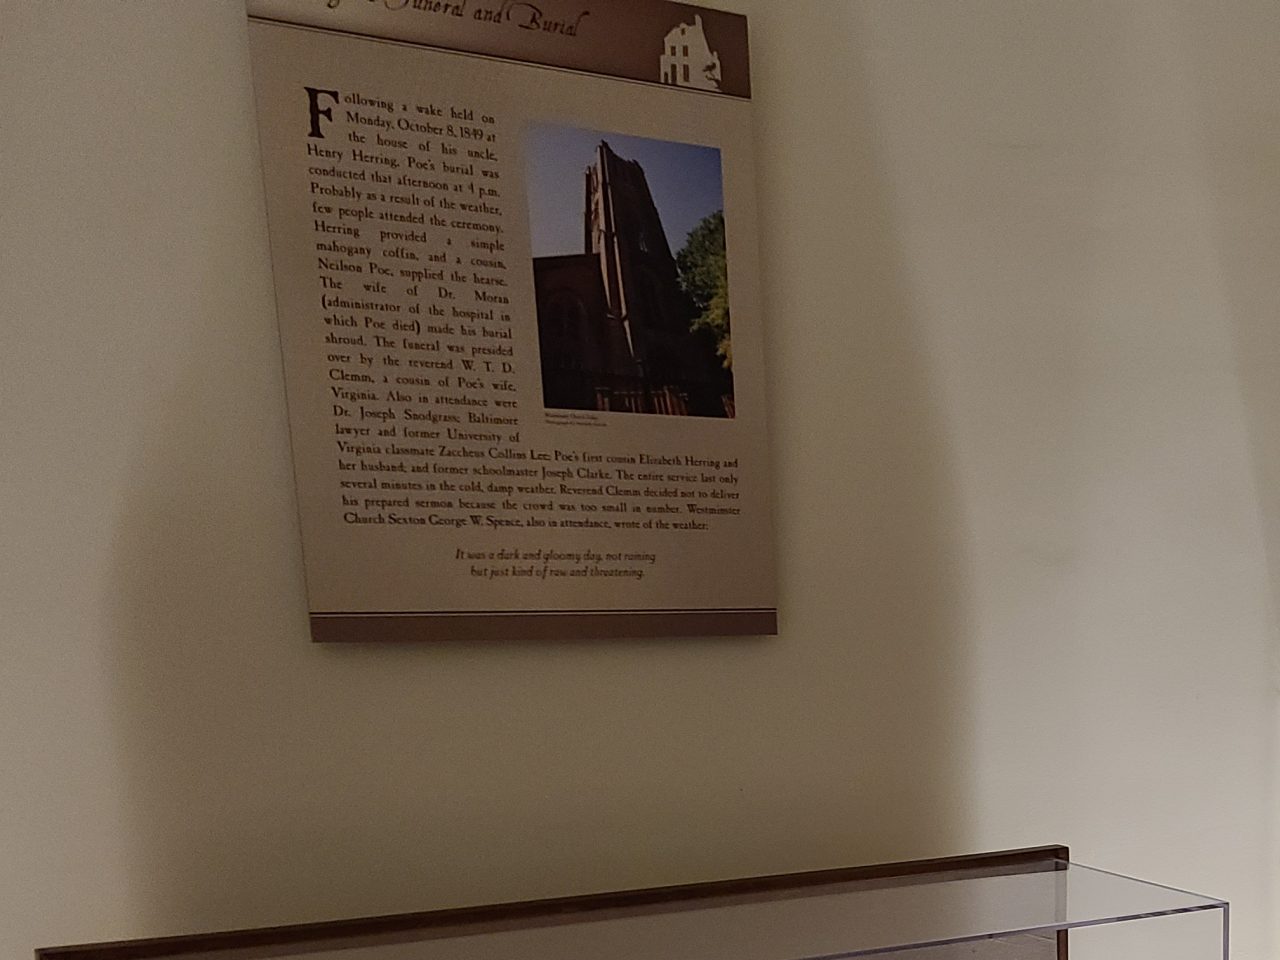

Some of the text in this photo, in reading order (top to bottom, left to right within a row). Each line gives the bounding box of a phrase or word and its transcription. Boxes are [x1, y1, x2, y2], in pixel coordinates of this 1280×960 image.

[473, 6, 502, 24] and
[506, 2, 590, 37] Burial
[415, 104, 442, 116] wake
[450, 106, 473, 121] held
[481, 115, 494, 124] on
[347, 130, 365, 143] the
[376, 133, 407, 148] house
[417, 140, 430, 151] of
[441, 142, 457, 154] his
[396, 118, 443, 135] October
[459, 126, 484, 139] 1849
[486, 133, 495, 142] at
[306, 142, 343, 160] Henry
[407, 156, 435, 170] Poe's
[442, 161, 473, 176] burial
[481, 170, 499, 178] was
[307, 166, 365, 181] conducted
[370, 170, 392, 183] that
[396, 174, 448, 190] afternoon
[453, 184, 462, 192] at
[310, 181, 362, 199] Probably
[366, 192, 377, 200] as
[389, 193, 419, 205] result
[422, 195, 435, 207] of
[439, 197, 455, 209] the
[312, 201, 332, 213] few
[337, 206, 374, 221] people
[378, 211, 424, 224] attended
[429, 214, 446, 226] the
[314, 219, 360, 238] Herring
[379, 230, 427, 242] provided
[470, 239, 504, 253] simple
[315, 240, 371, 256] mahogany
[427, 252, 446, 262] and
[317, 257, 362, 273] Neilson
[399, 267, 444, 282] supplied
[450, 270, 466, 282] the
[319, 275, 342, 289] The
[362, 281, 386, 293] wife
[405, 285, 418, 296] of
[474, 289, 509, 304] Moran
[320, 293, 401, 312] (administrator
[407, 303, 420, 314] of
[428, 304, 444, 316] the
[451, 306, 493, 322] hospital
[323, 313, 511, 339] which Poe died) made his burial
[373, 335, 395, 348] The
[402, 337, 440, 351] funeral
[446, 344, 464, 353] was
[471, 344, 513, 357] presided
[327, 352, 453, 369] over by the reverend
[395, 377, 430, 385] cousin
[437, 376, 449, 387] of
[457, 376, 484, 389] Poe's
[385, 390, 412, 402] Also
[418, 395, 428, 403] in
[434, 395, 487, 406] attendance
[494, 400, 517, 408] were
[360, 406, 396, 422] Joseph
[468, 411, 518, 425] Baltimore
[334, 423, 520, 442] lawyer and former University of
[438, 445, 485, 457] Zaccheus
[554, 449, 579, 461] Poe's
[684, 455, 720, 470] Herring
[723, 458, 738, 467] and
[338, 458, 738, 483] her and former schoolmaster Joseph The last only
[438, 480, 455, 491] the
[486, 482, 514, 496] damp
[559, 483, 603, 495] Reverend
[605, 485, 640, 496] Clemm
[710, 489, 739, 499] deliver
[501, 499, 517, 510] the
[522, 500, 553, 510] crowd
[580, 503, 597, 511] too
[601, 502, 627, 512] small
[427, 513, 467, 528] George
[642, 519, 652, 529] of
[655, 519, 669, 529] the
[454, 548, 621, 560] It dark not
[470, 565, 487, 576] but
[568, 565, 587, 576] and
